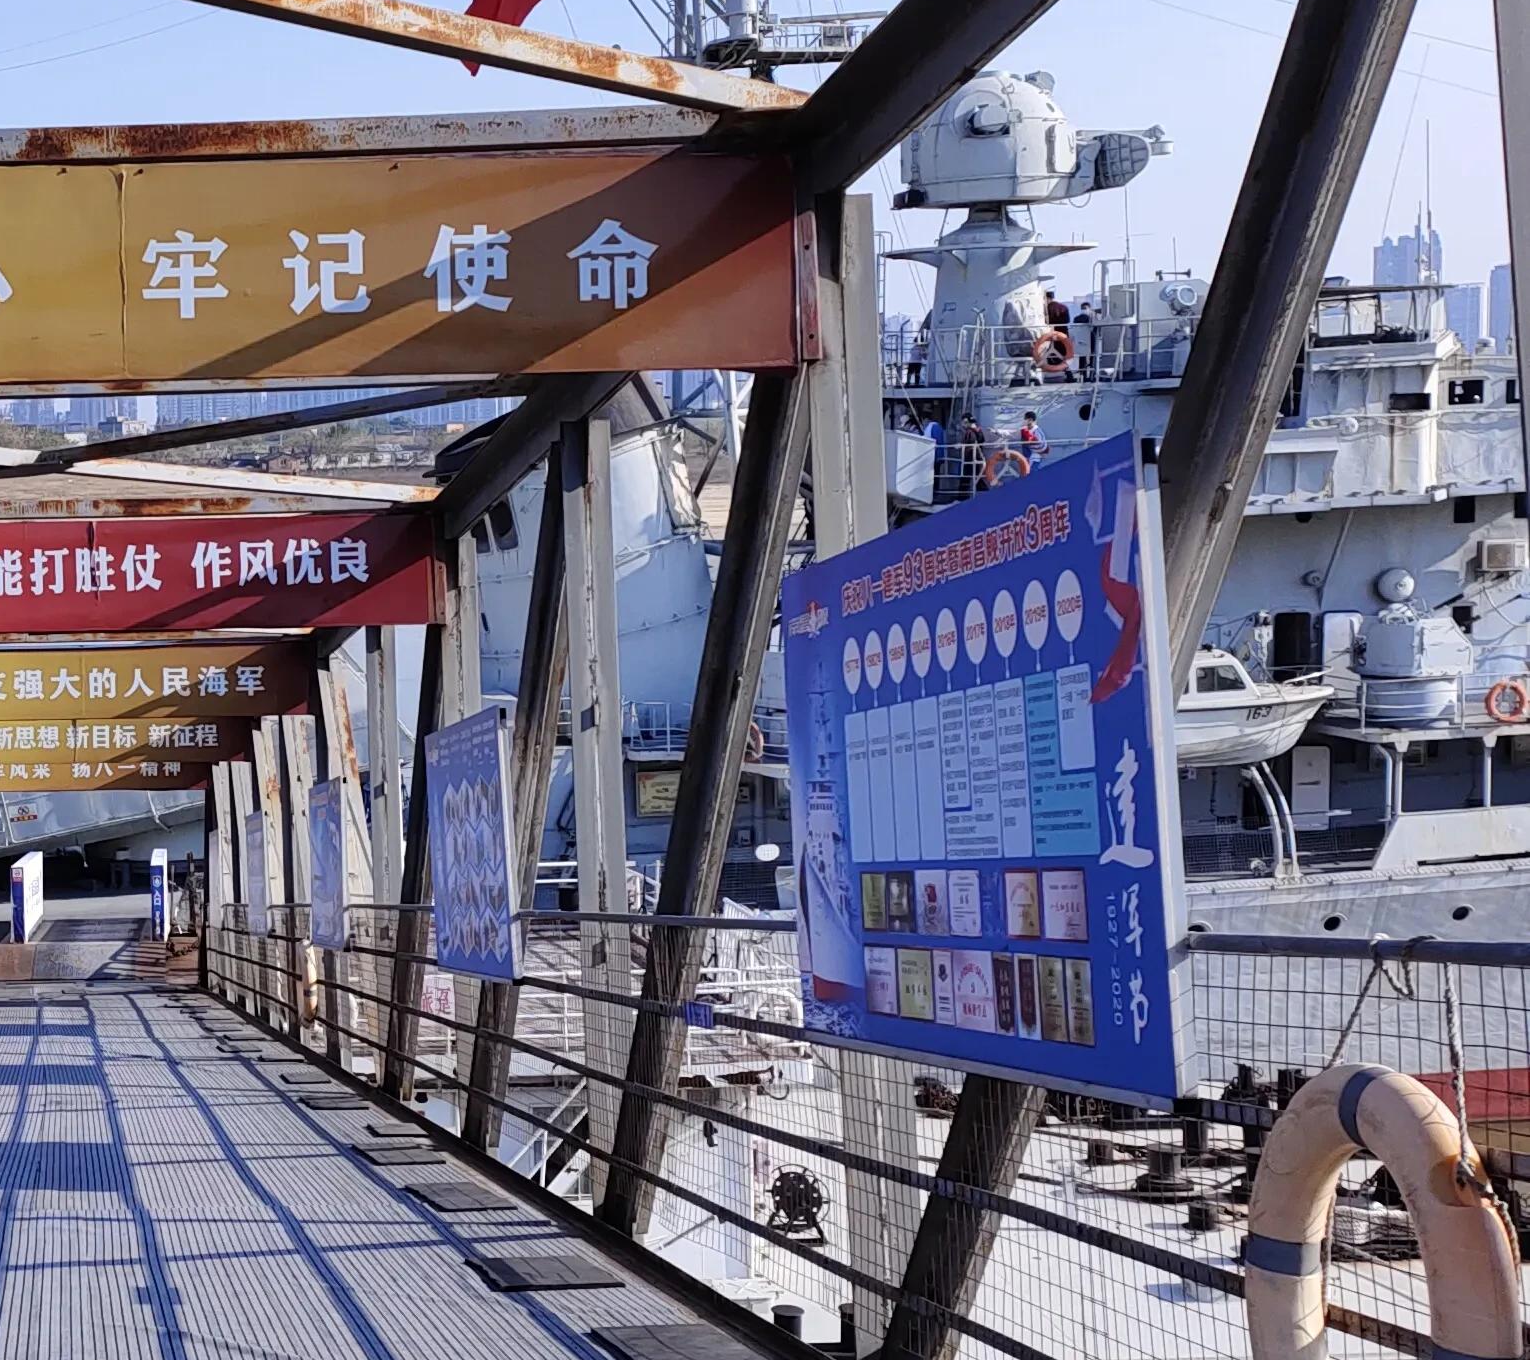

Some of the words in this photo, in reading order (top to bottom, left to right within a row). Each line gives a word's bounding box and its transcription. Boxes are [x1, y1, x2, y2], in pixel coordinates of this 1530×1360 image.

[140, 218, 656, 319] 牢记使命
[189, 537, 369, 589] 作风优良
[65, 724, 138, 749] 新目标
[147, 723, 219, 747] 新征程
[1245, 705, 1273, 722] 163
[1103, 892, 1125, 1027] 1927-2020
